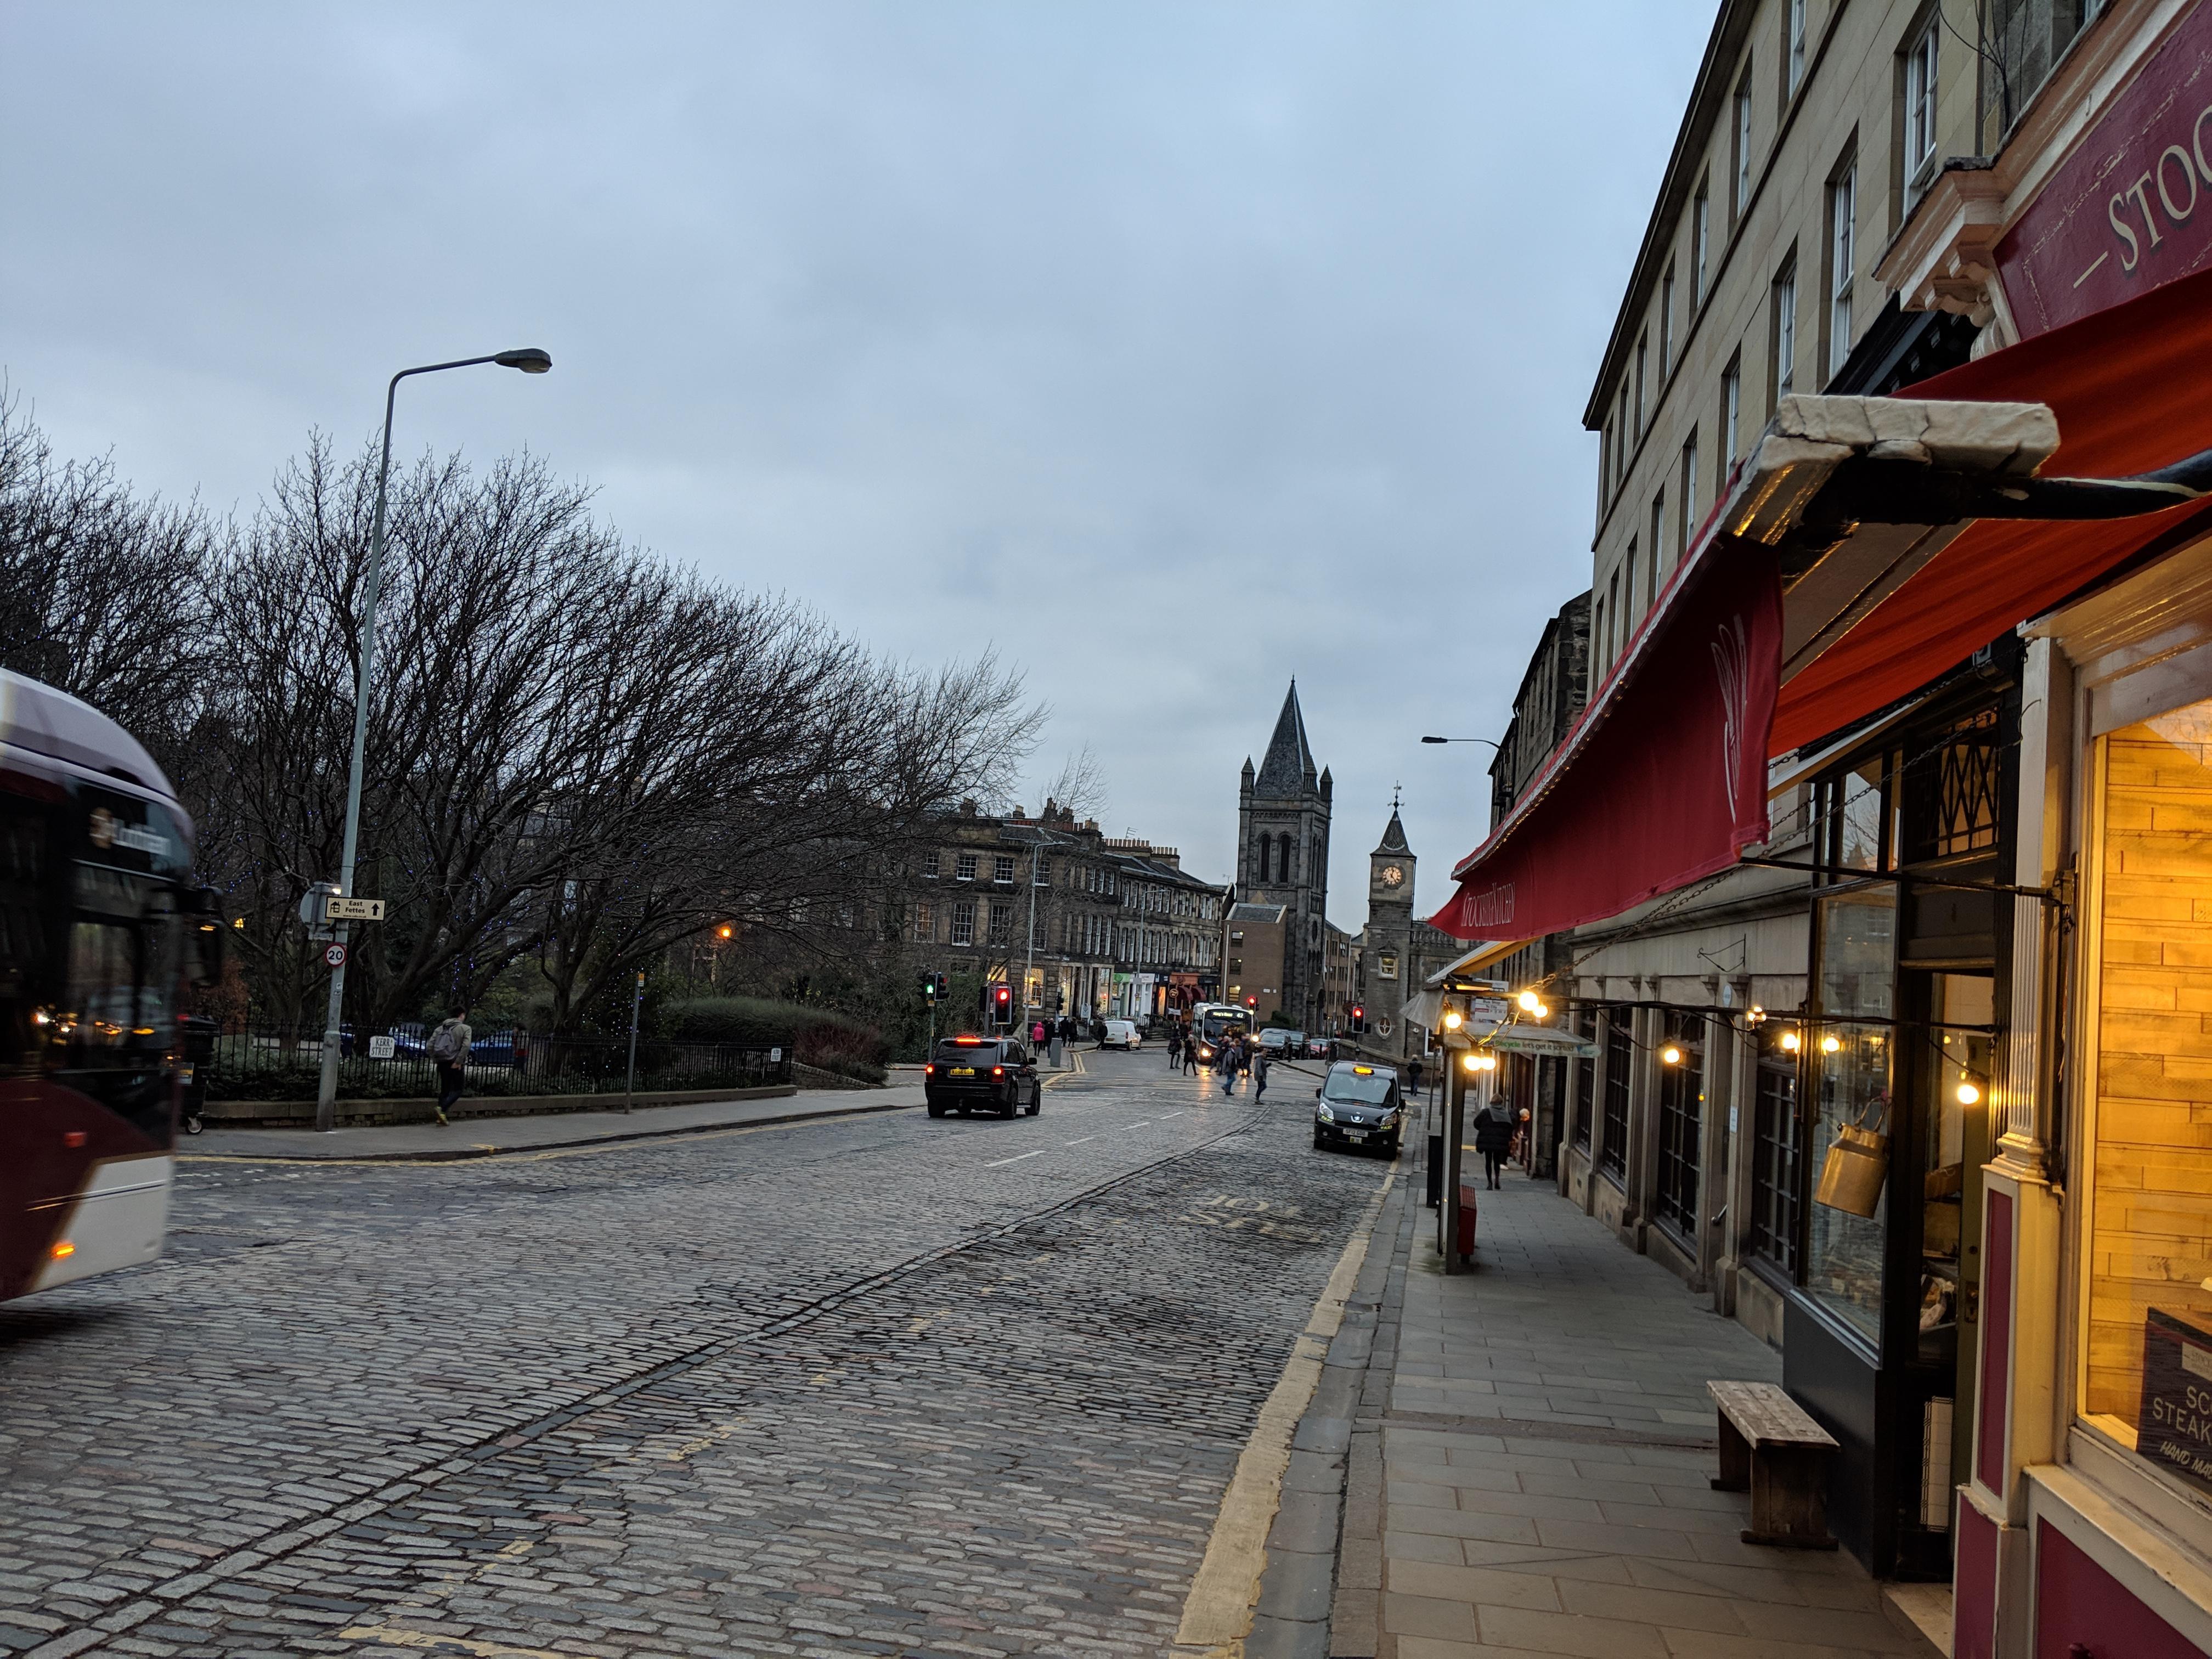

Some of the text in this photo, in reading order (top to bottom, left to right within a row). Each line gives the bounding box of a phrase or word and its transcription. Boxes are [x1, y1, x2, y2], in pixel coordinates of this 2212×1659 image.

[328, 950, 343, 960] 20
[375, 1037, 390, 1047] KERR
[371, 1047, 392, 1056] STREET
[2186, 1385, 2212, 1415] SC
[2152, 1397, 2212, 1446] STEAK
[2160, 1440, 2191, 1465] HAND
